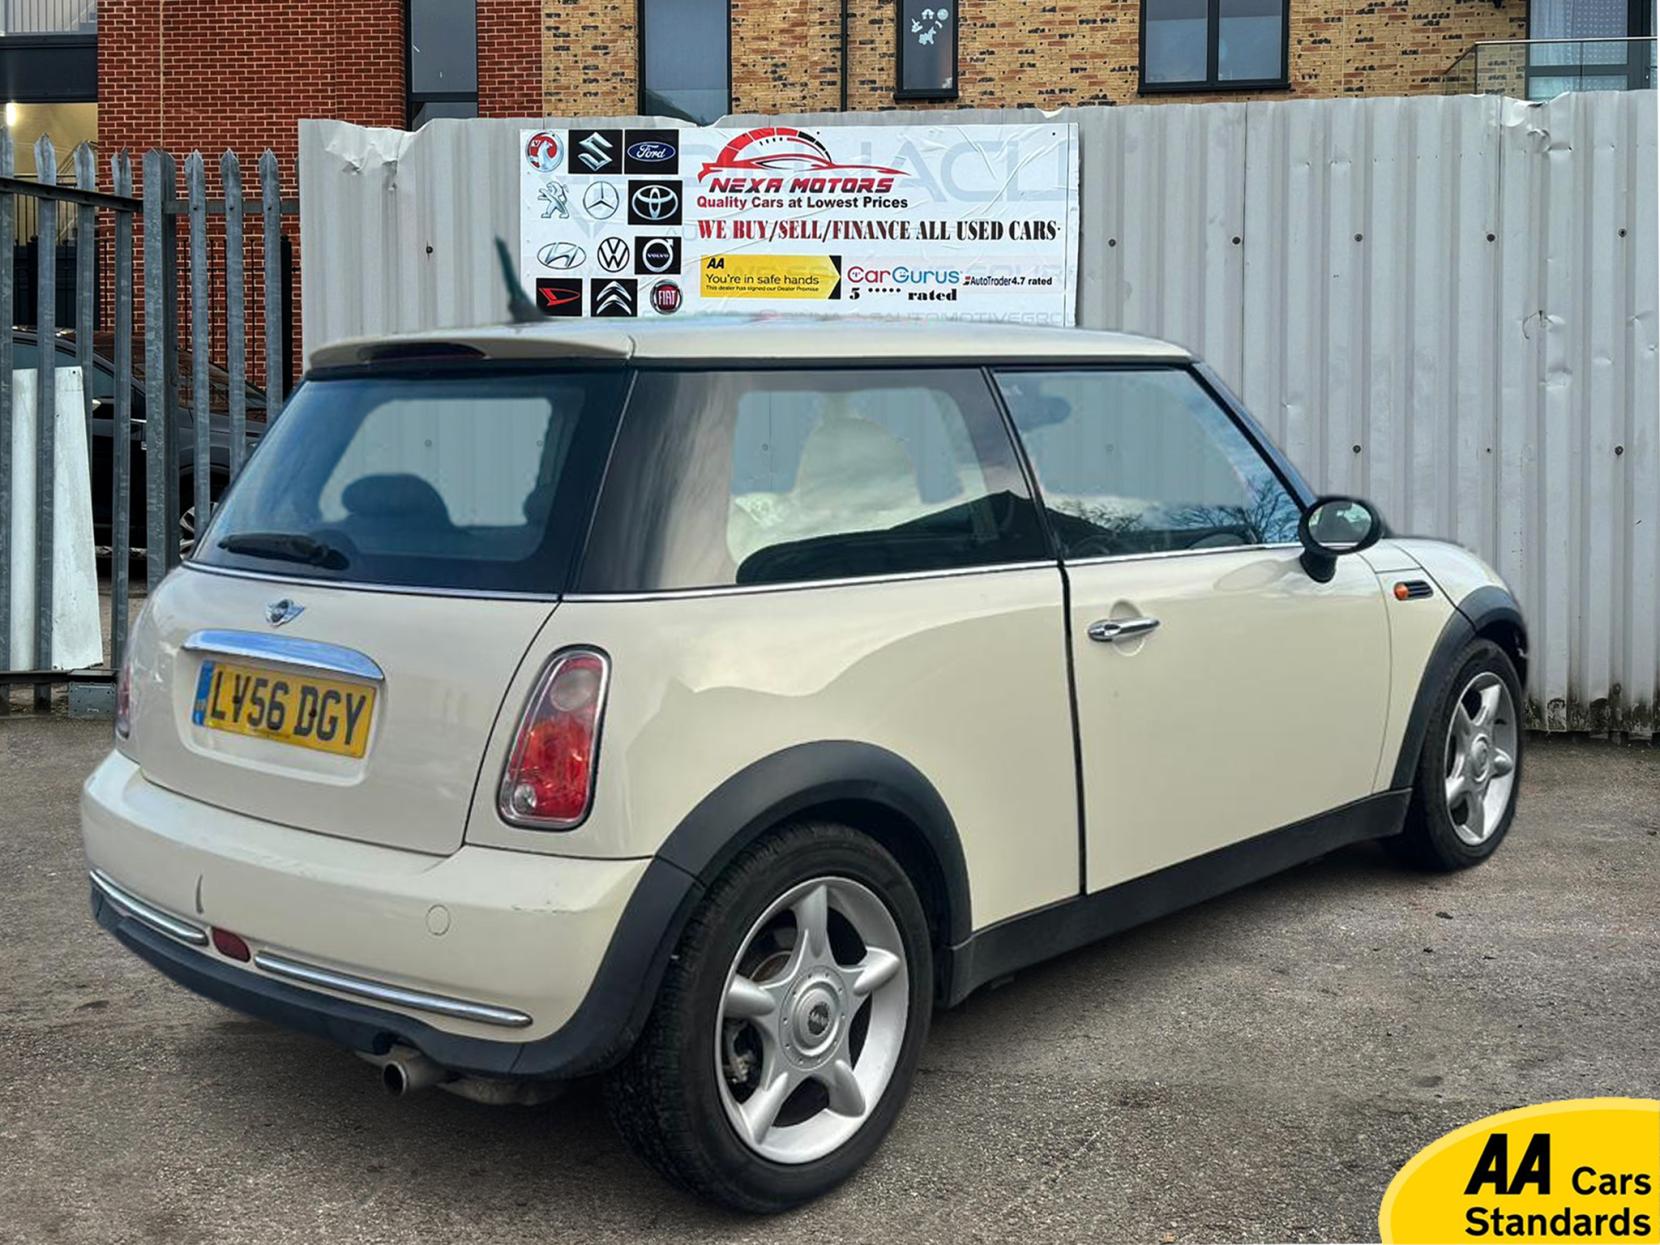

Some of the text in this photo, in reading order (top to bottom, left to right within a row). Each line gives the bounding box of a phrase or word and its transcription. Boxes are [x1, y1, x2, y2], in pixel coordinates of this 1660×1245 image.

[635, 144, 666, 158] Ford
[709, 177, 894, 193] NEXA MOTORS
[697, 196, 908, 210] Quality Cars at Lowest Prices
[698, 220, 726, 240] WE
[732, 220, 911, 242] BUY/SELL/FINANCE
[916, 221, 951, 240] ALL
[957, 220, 1003, 241] USED
[1009, 220, 1057, 241] CARS
[706, 257, 725, 269] AA
[706, 273, 820, 285] You're in safe hands
[847, 265, 960, 284] CarGurus
[1028, 276, 1053, 286] rated
[658, 290, 676, 305] FIAT
[850, 287, 957, 301] 5 rated
[211, 671, 367, 746] LV56 DGY
